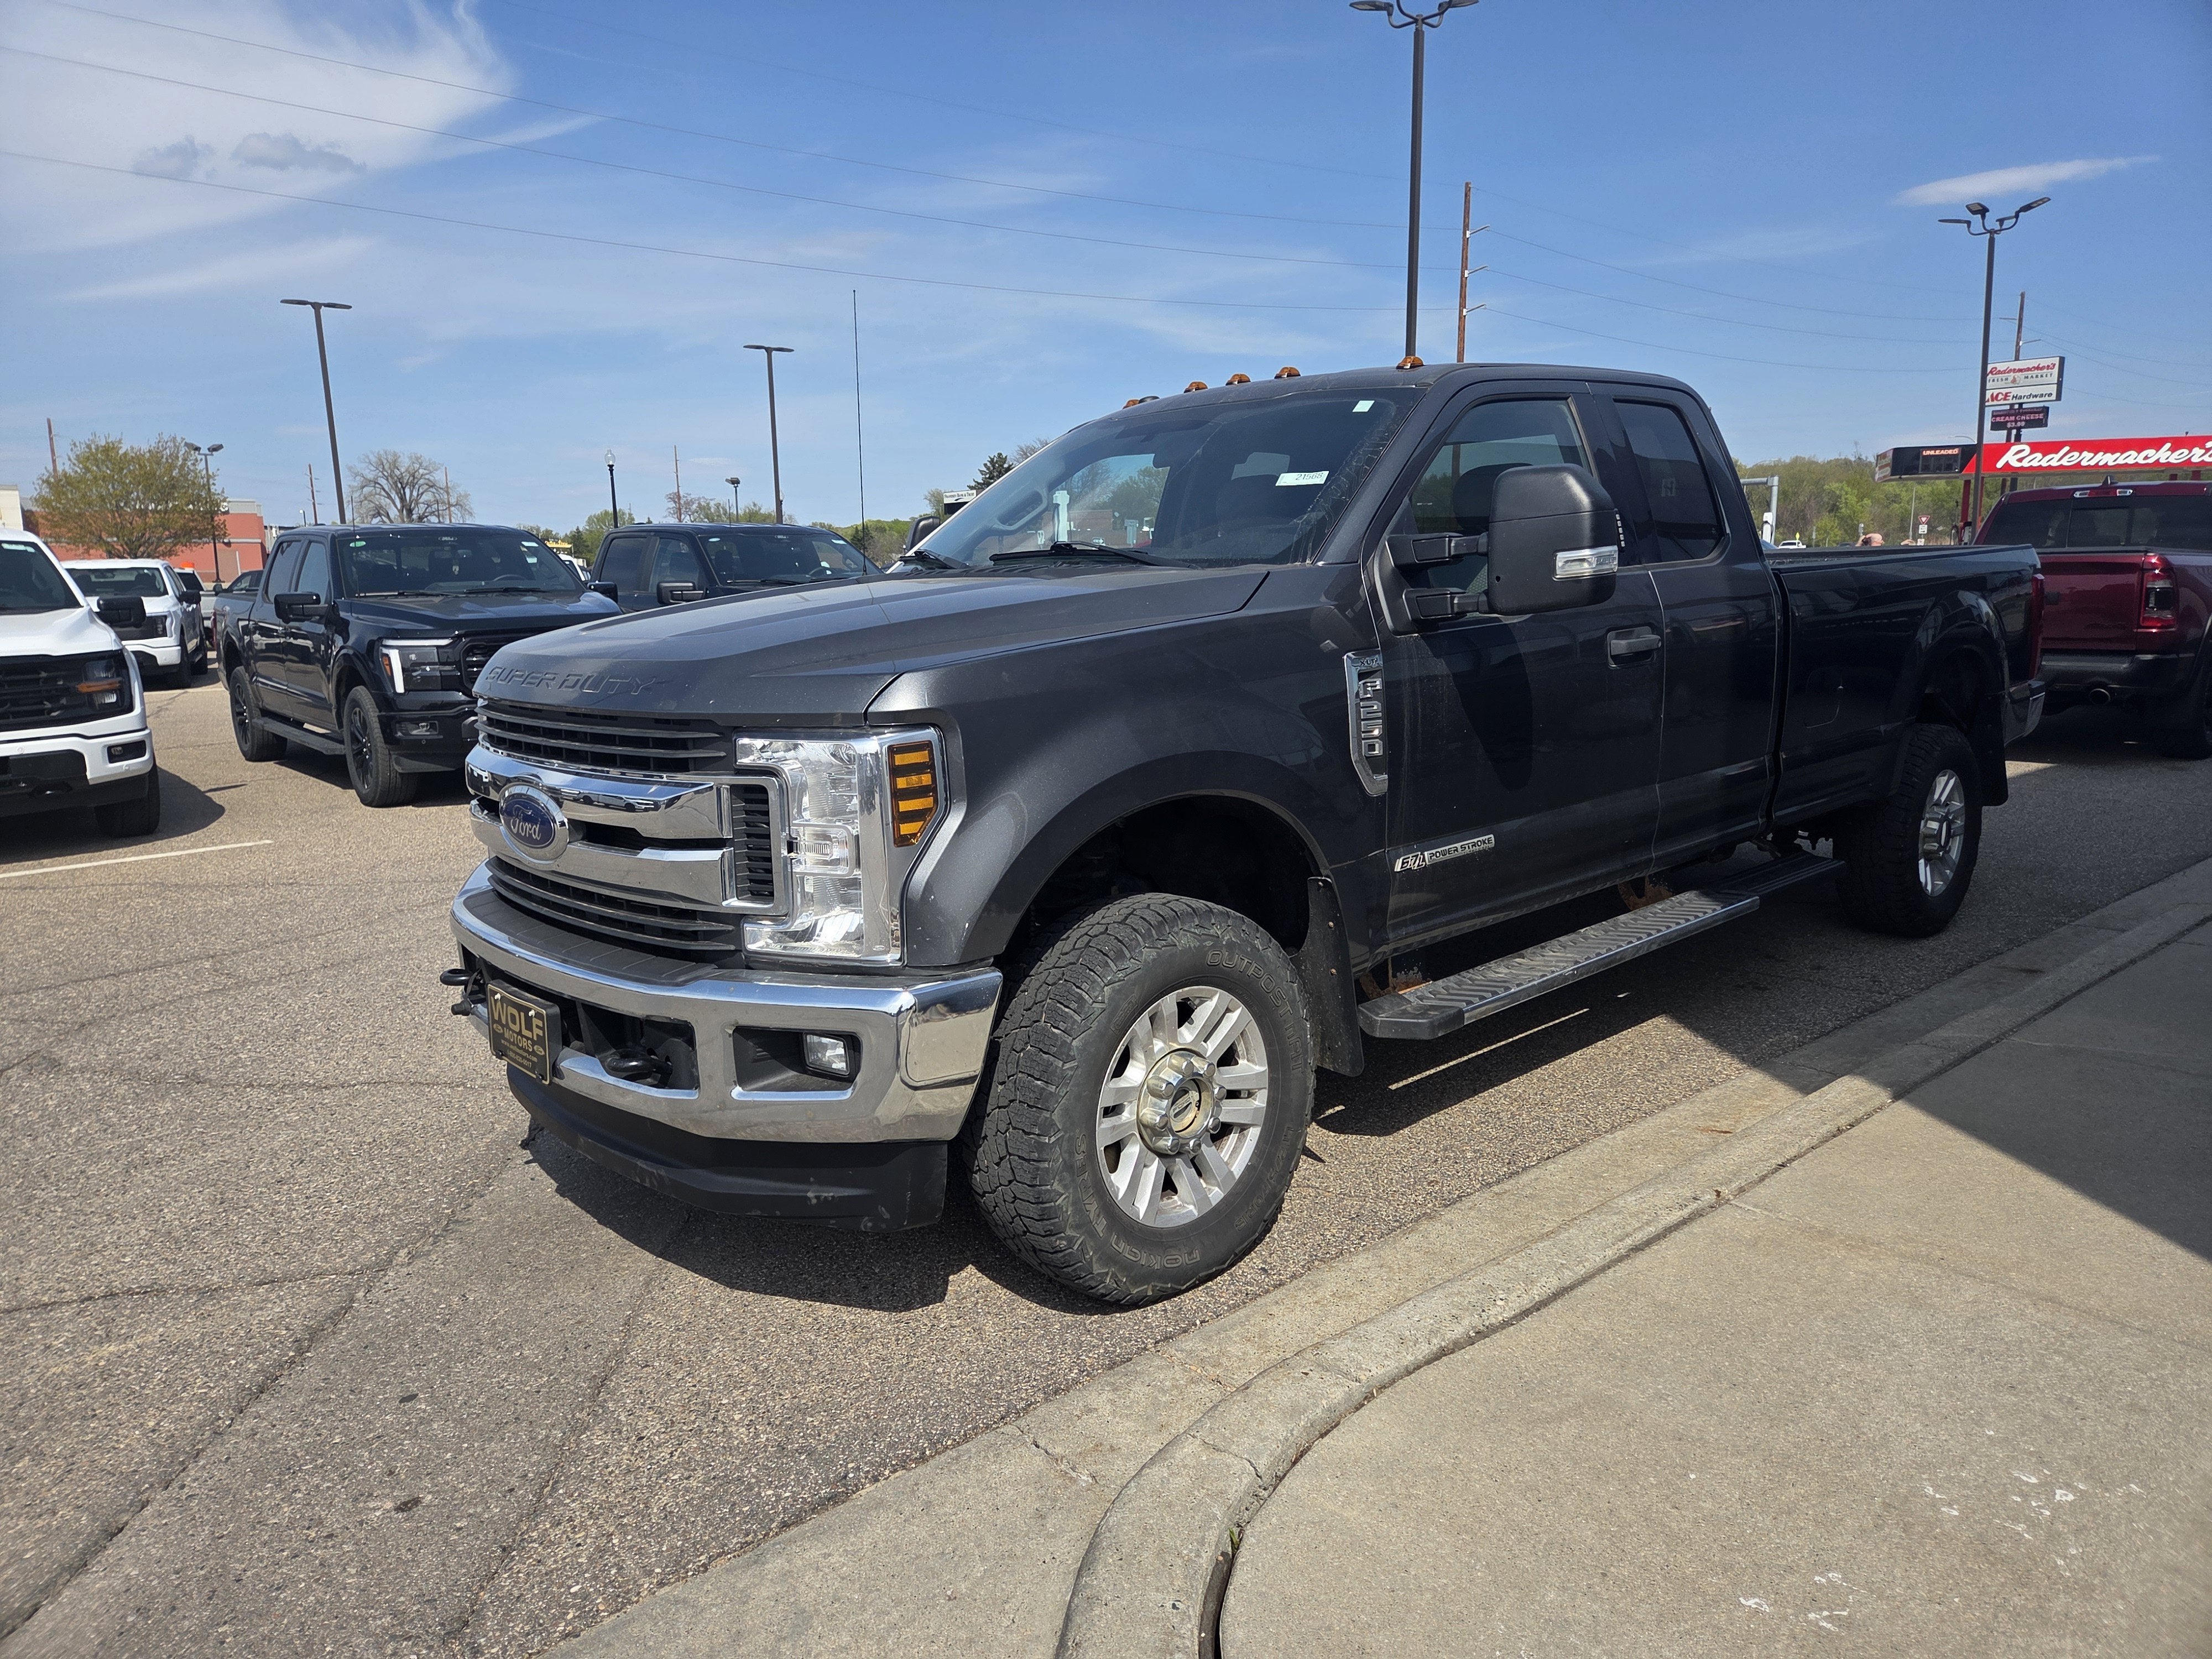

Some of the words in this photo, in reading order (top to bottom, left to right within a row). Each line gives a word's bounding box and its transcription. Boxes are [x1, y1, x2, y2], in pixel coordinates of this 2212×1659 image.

[1987, 363, 2056, 375] Radermacher's
[1985, 392, 2012, 402] ACE
[2011, 392, 2053, 401] Hardware
[1295, 472, 1323, 481] 21568
[1360, 657, 1378, 666] XLT
[486, 666, 559, 690] SUPER
[558, 673, 656, 695] DUTY
[510, 804, 541, 841] Ford
[1428, 846, 1459, 861] POWER
[1460, 836, 1493, 852] STROKE
[1207, 949, 1293, 1018] OUTPOST
[491, 996, 543, 1041] WOLF
[504, 1027, 533, 1052] MOTORS
[1074, 1132, 1108, 1238] TYRES
